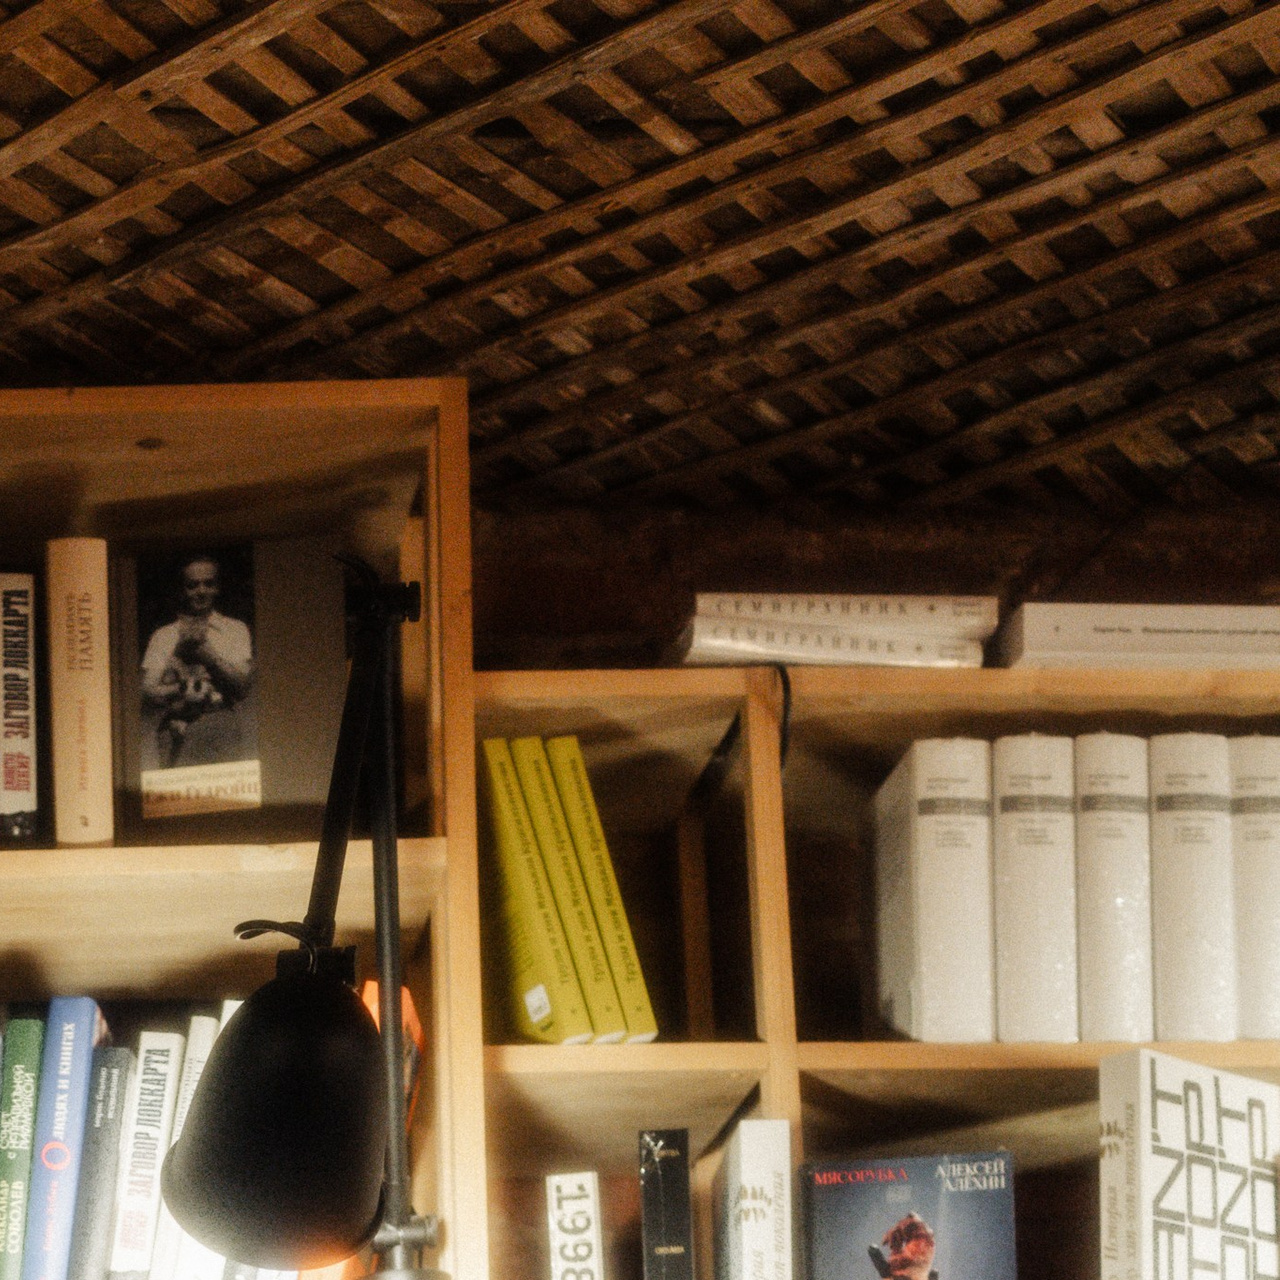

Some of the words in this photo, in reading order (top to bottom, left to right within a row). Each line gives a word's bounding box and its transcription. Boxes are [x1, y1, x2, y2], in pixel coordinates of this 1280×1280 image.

[3, 588, 29, 671] ЛОККАРТА
[3, 674, 30, 739] ЗАГОВОР
[41, 1141, 71, 1171] О
[60, 1022, 76, 1076] книгах
[132, 1047, 171, 1130] ЛОККАРТА
[814, 1166, 909, 1186] МЯСОРУБКА
[935, 1158, 1006, 1179] АЛЕКСЕЙ
[8, 1179, 25, 1255] СОБОЛЕВ
